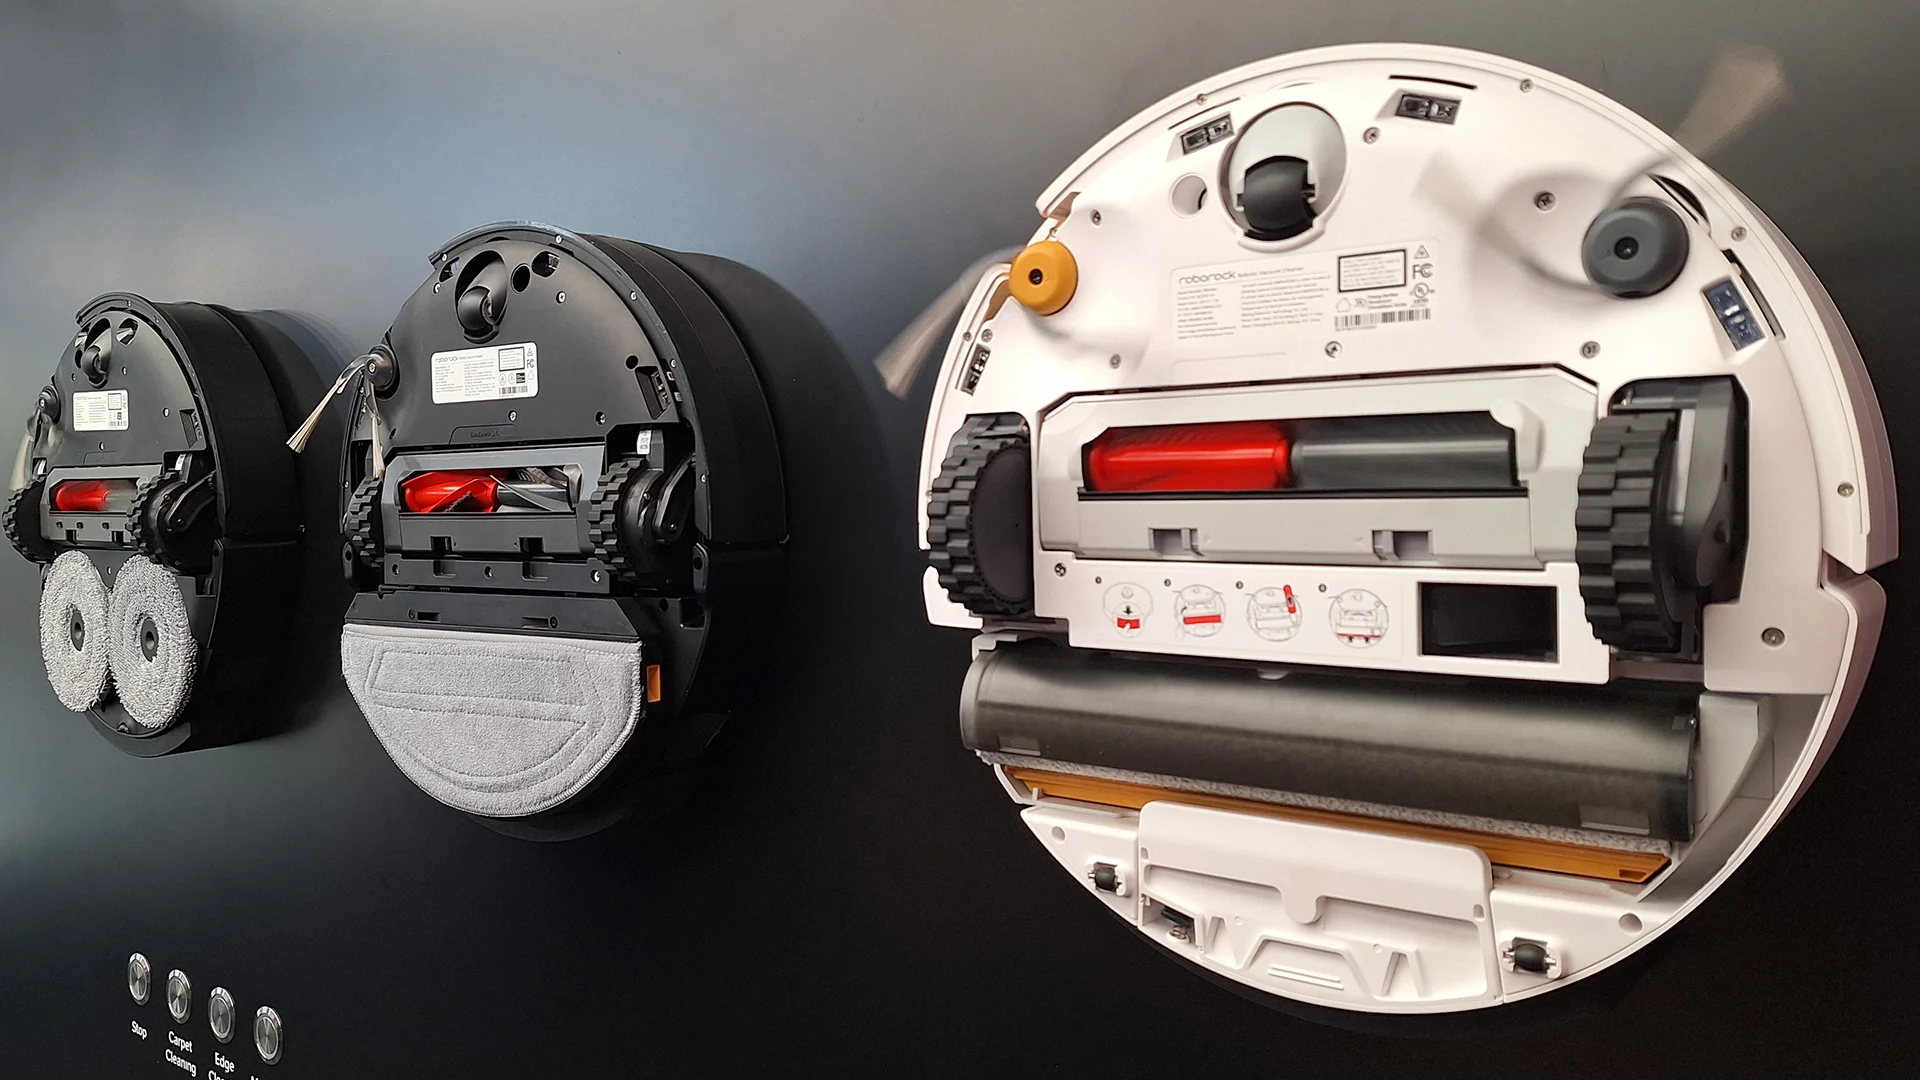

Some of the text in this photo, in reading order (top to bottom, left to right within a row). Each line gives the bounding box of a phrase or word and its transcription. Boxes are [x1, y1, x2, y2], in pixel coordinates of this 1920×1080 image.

[1179, 271, 1235, 284] roborock
[131, 1020, 148, 1040] Stop
[168, 1031, 193, 1053] Carpet
[165, 1049, 197, 1077] Cleaning
[214, 1051, 235, 1073] Edge
